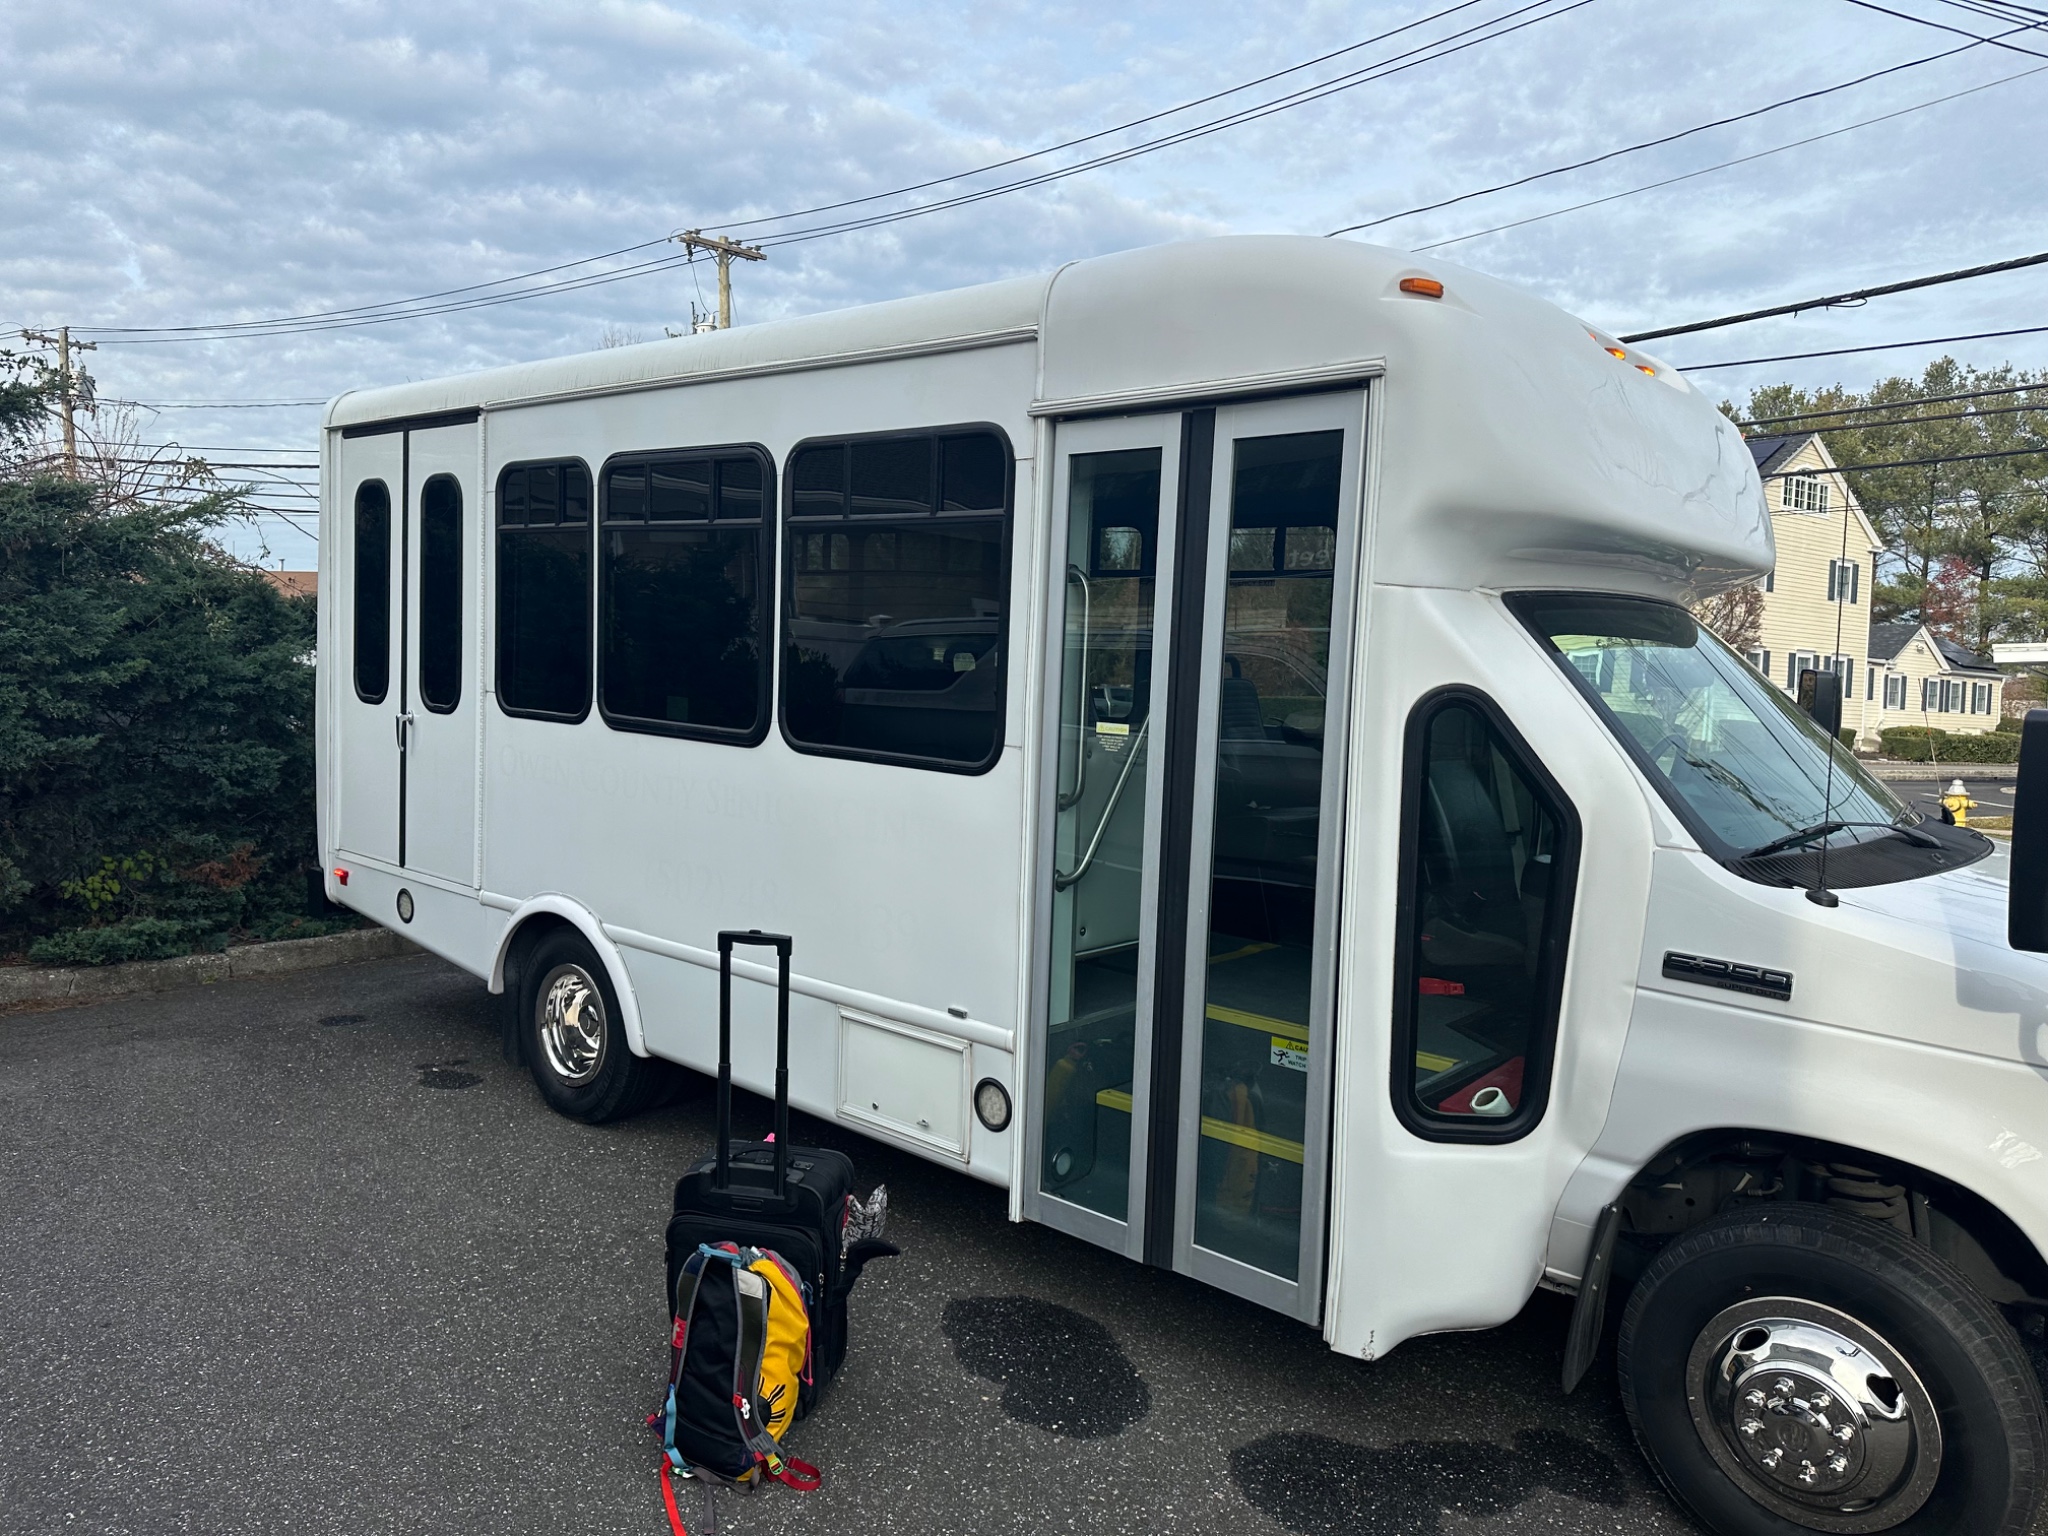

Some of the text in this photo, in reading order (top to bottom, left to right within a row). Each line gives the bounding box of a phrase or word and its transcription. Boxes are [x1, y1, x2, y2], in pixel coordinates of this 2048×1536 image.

[579, 758, 698, 812] COUNTY
[1717, 981, 1753, 993] SUPER
[1287, 1060, 1307, 1068] WATCH
